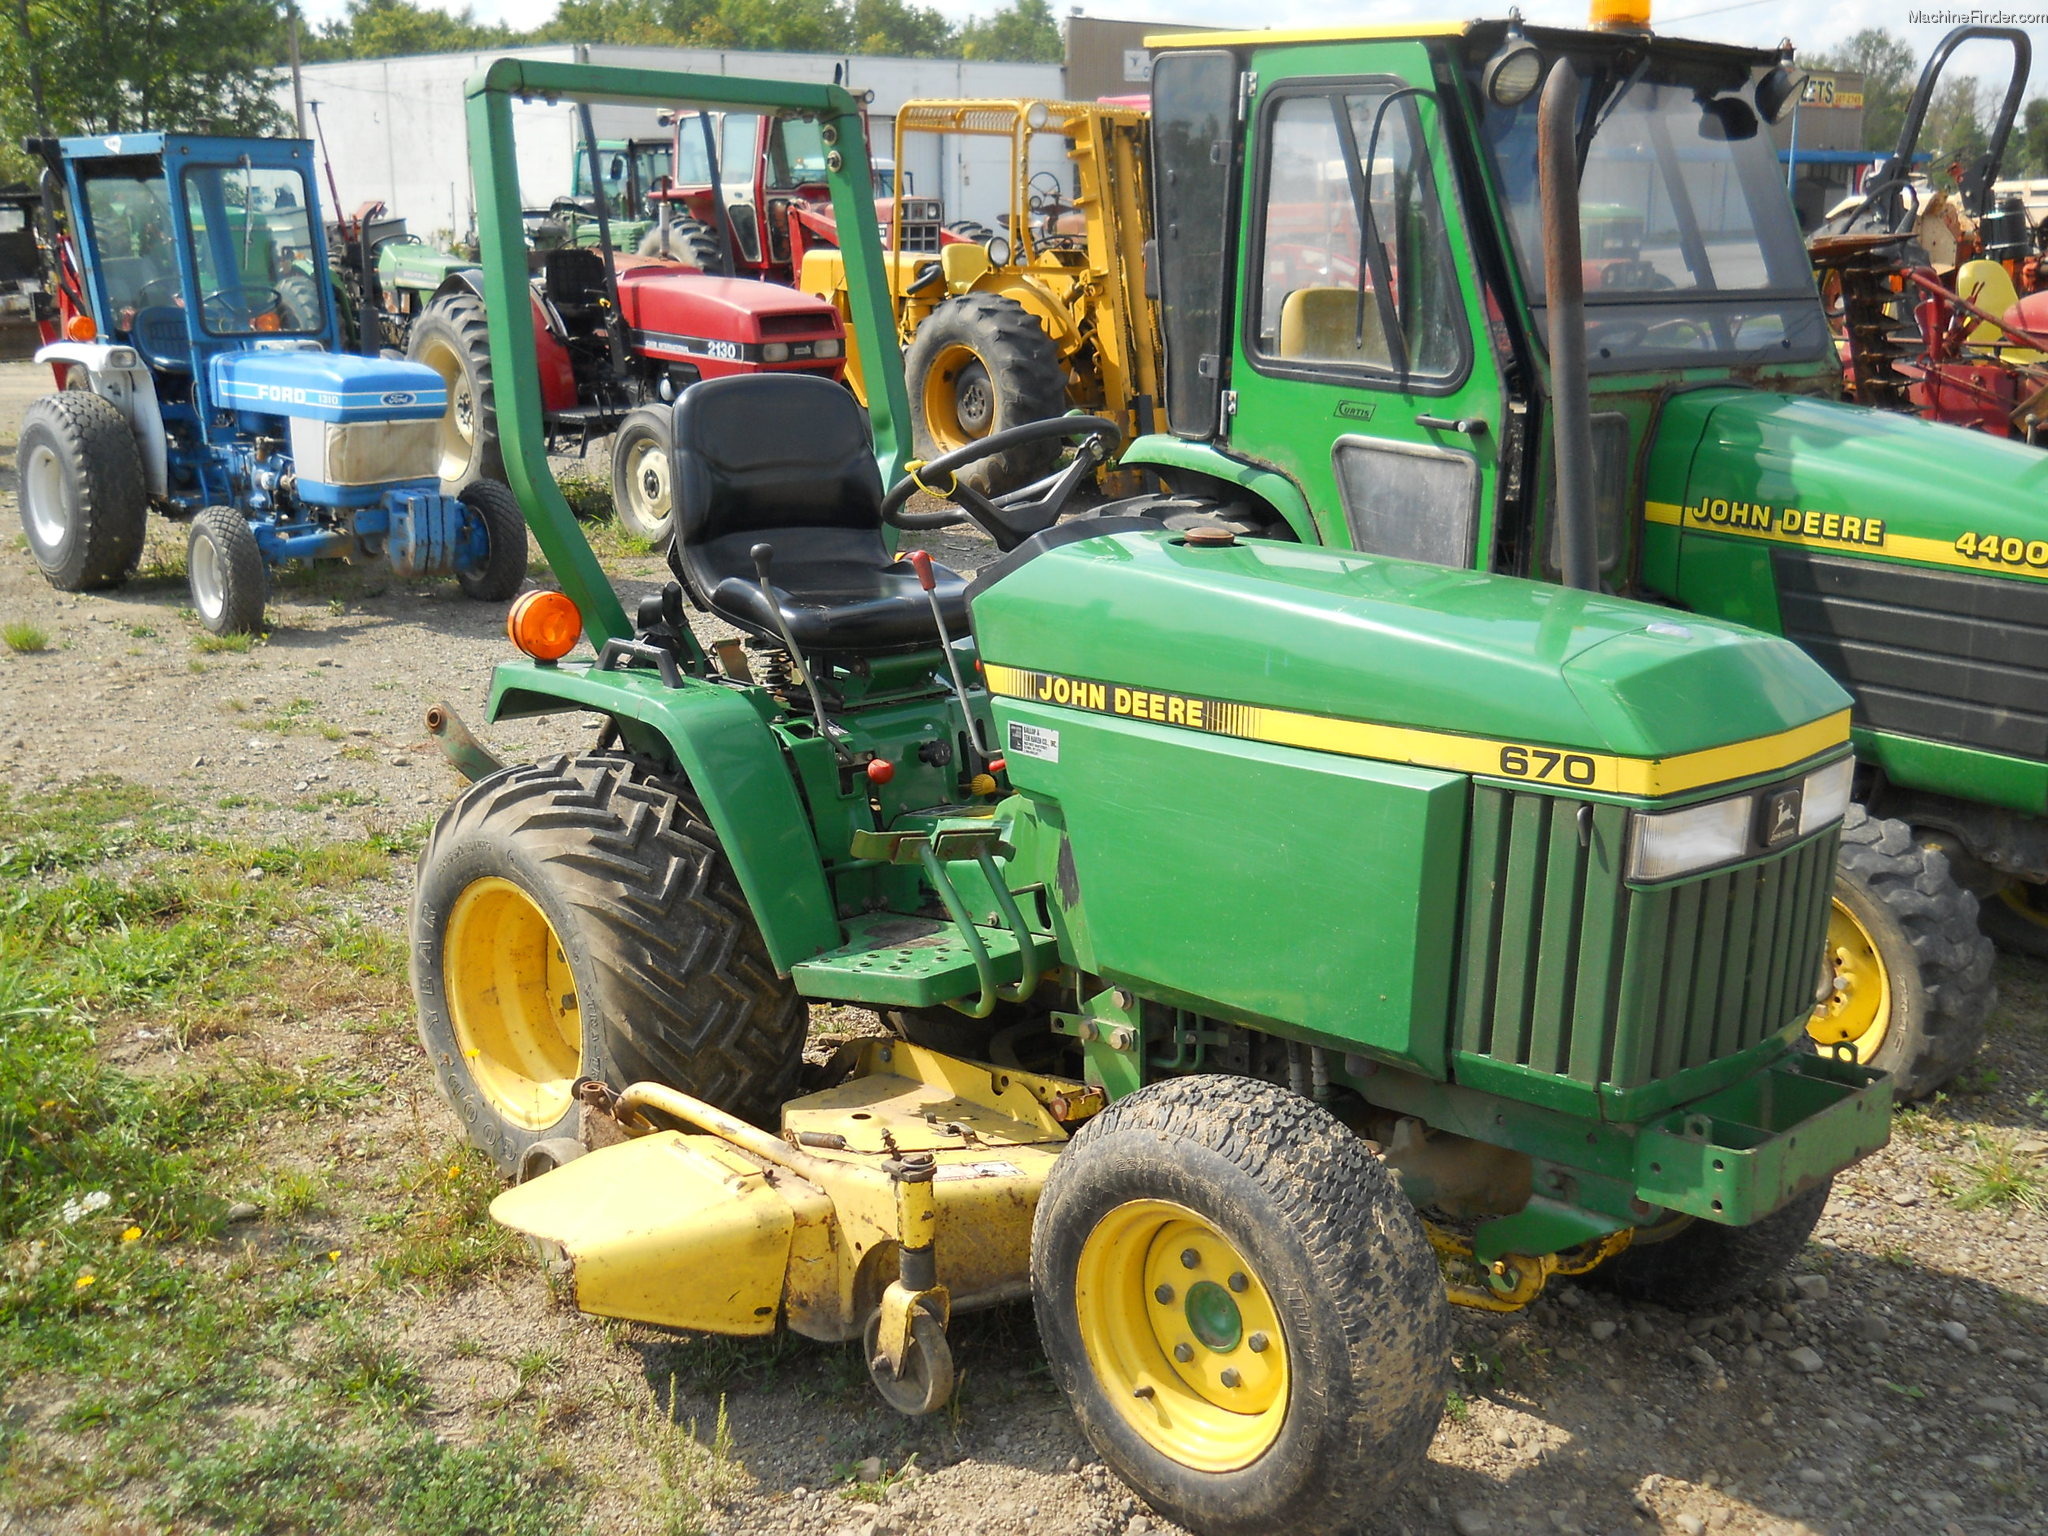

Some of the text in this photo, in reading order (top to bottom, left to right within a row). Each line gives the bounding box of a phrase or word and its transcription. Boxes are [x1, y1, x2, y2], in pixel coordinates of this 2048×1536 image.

[707, 340, 737, 359] 2130
[257, 384, 340, 405] FORD 1310
[1693, 497, 1885, 547] JOHN DEERE
[1953, 531, 2048, 567] 4400
[1038, 675, 1204, 728] JOHN DEERE
[1499, 745, 1596, 786] 670
